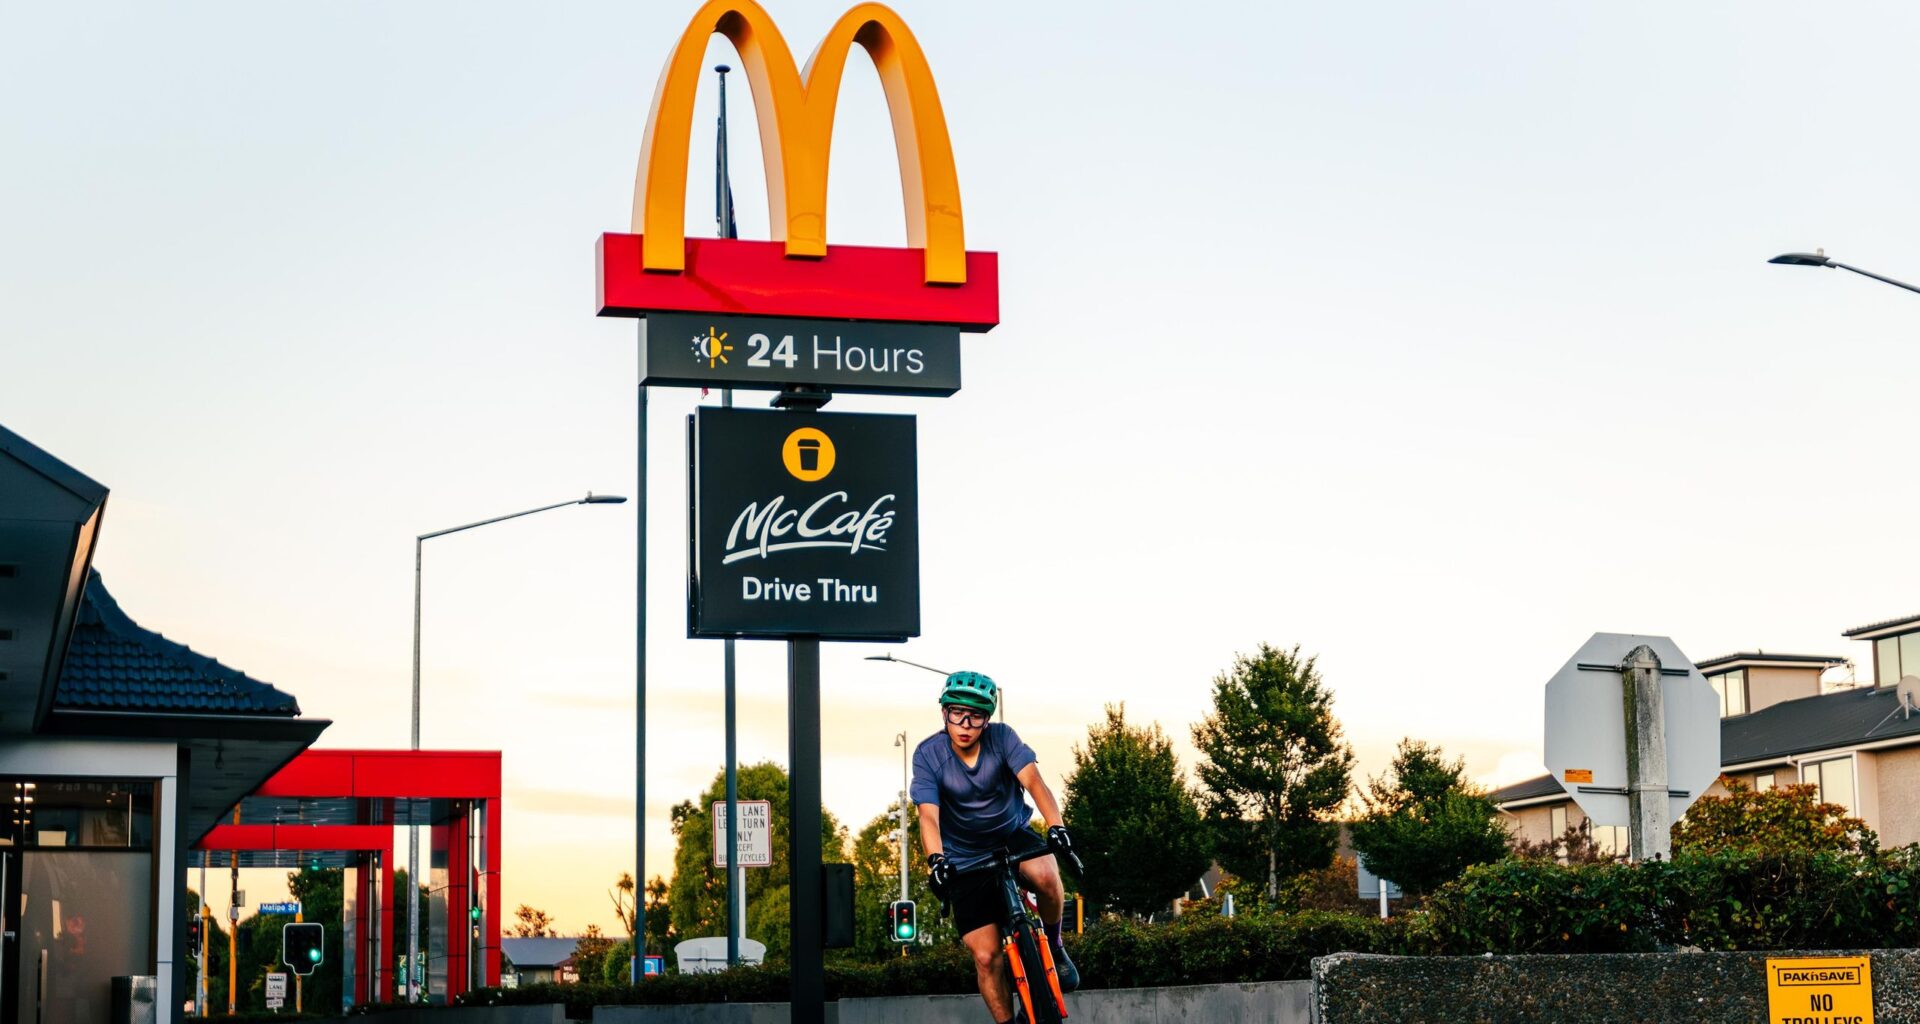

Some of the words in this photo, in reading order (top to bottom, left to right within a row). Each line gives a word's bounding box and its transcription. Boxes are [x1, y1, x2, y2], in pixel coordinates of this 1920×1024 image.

[747, 333, 798, 368] 24
[813, 335, 924, 374] Hours
[726, 491, 896, 559] McCafé
[742, 576, 811, 601] Drive
[817, 578, 878, 602] Thru
[743, 806, 764, 816] LANE
[743, 818, 765, 828] TURN
[737, 831, 752, 841] NLY
[262, 903, 286, 912] Matipo
[288, 903, 296, 911] St
[1810, 994, 1833, 1012] NO
